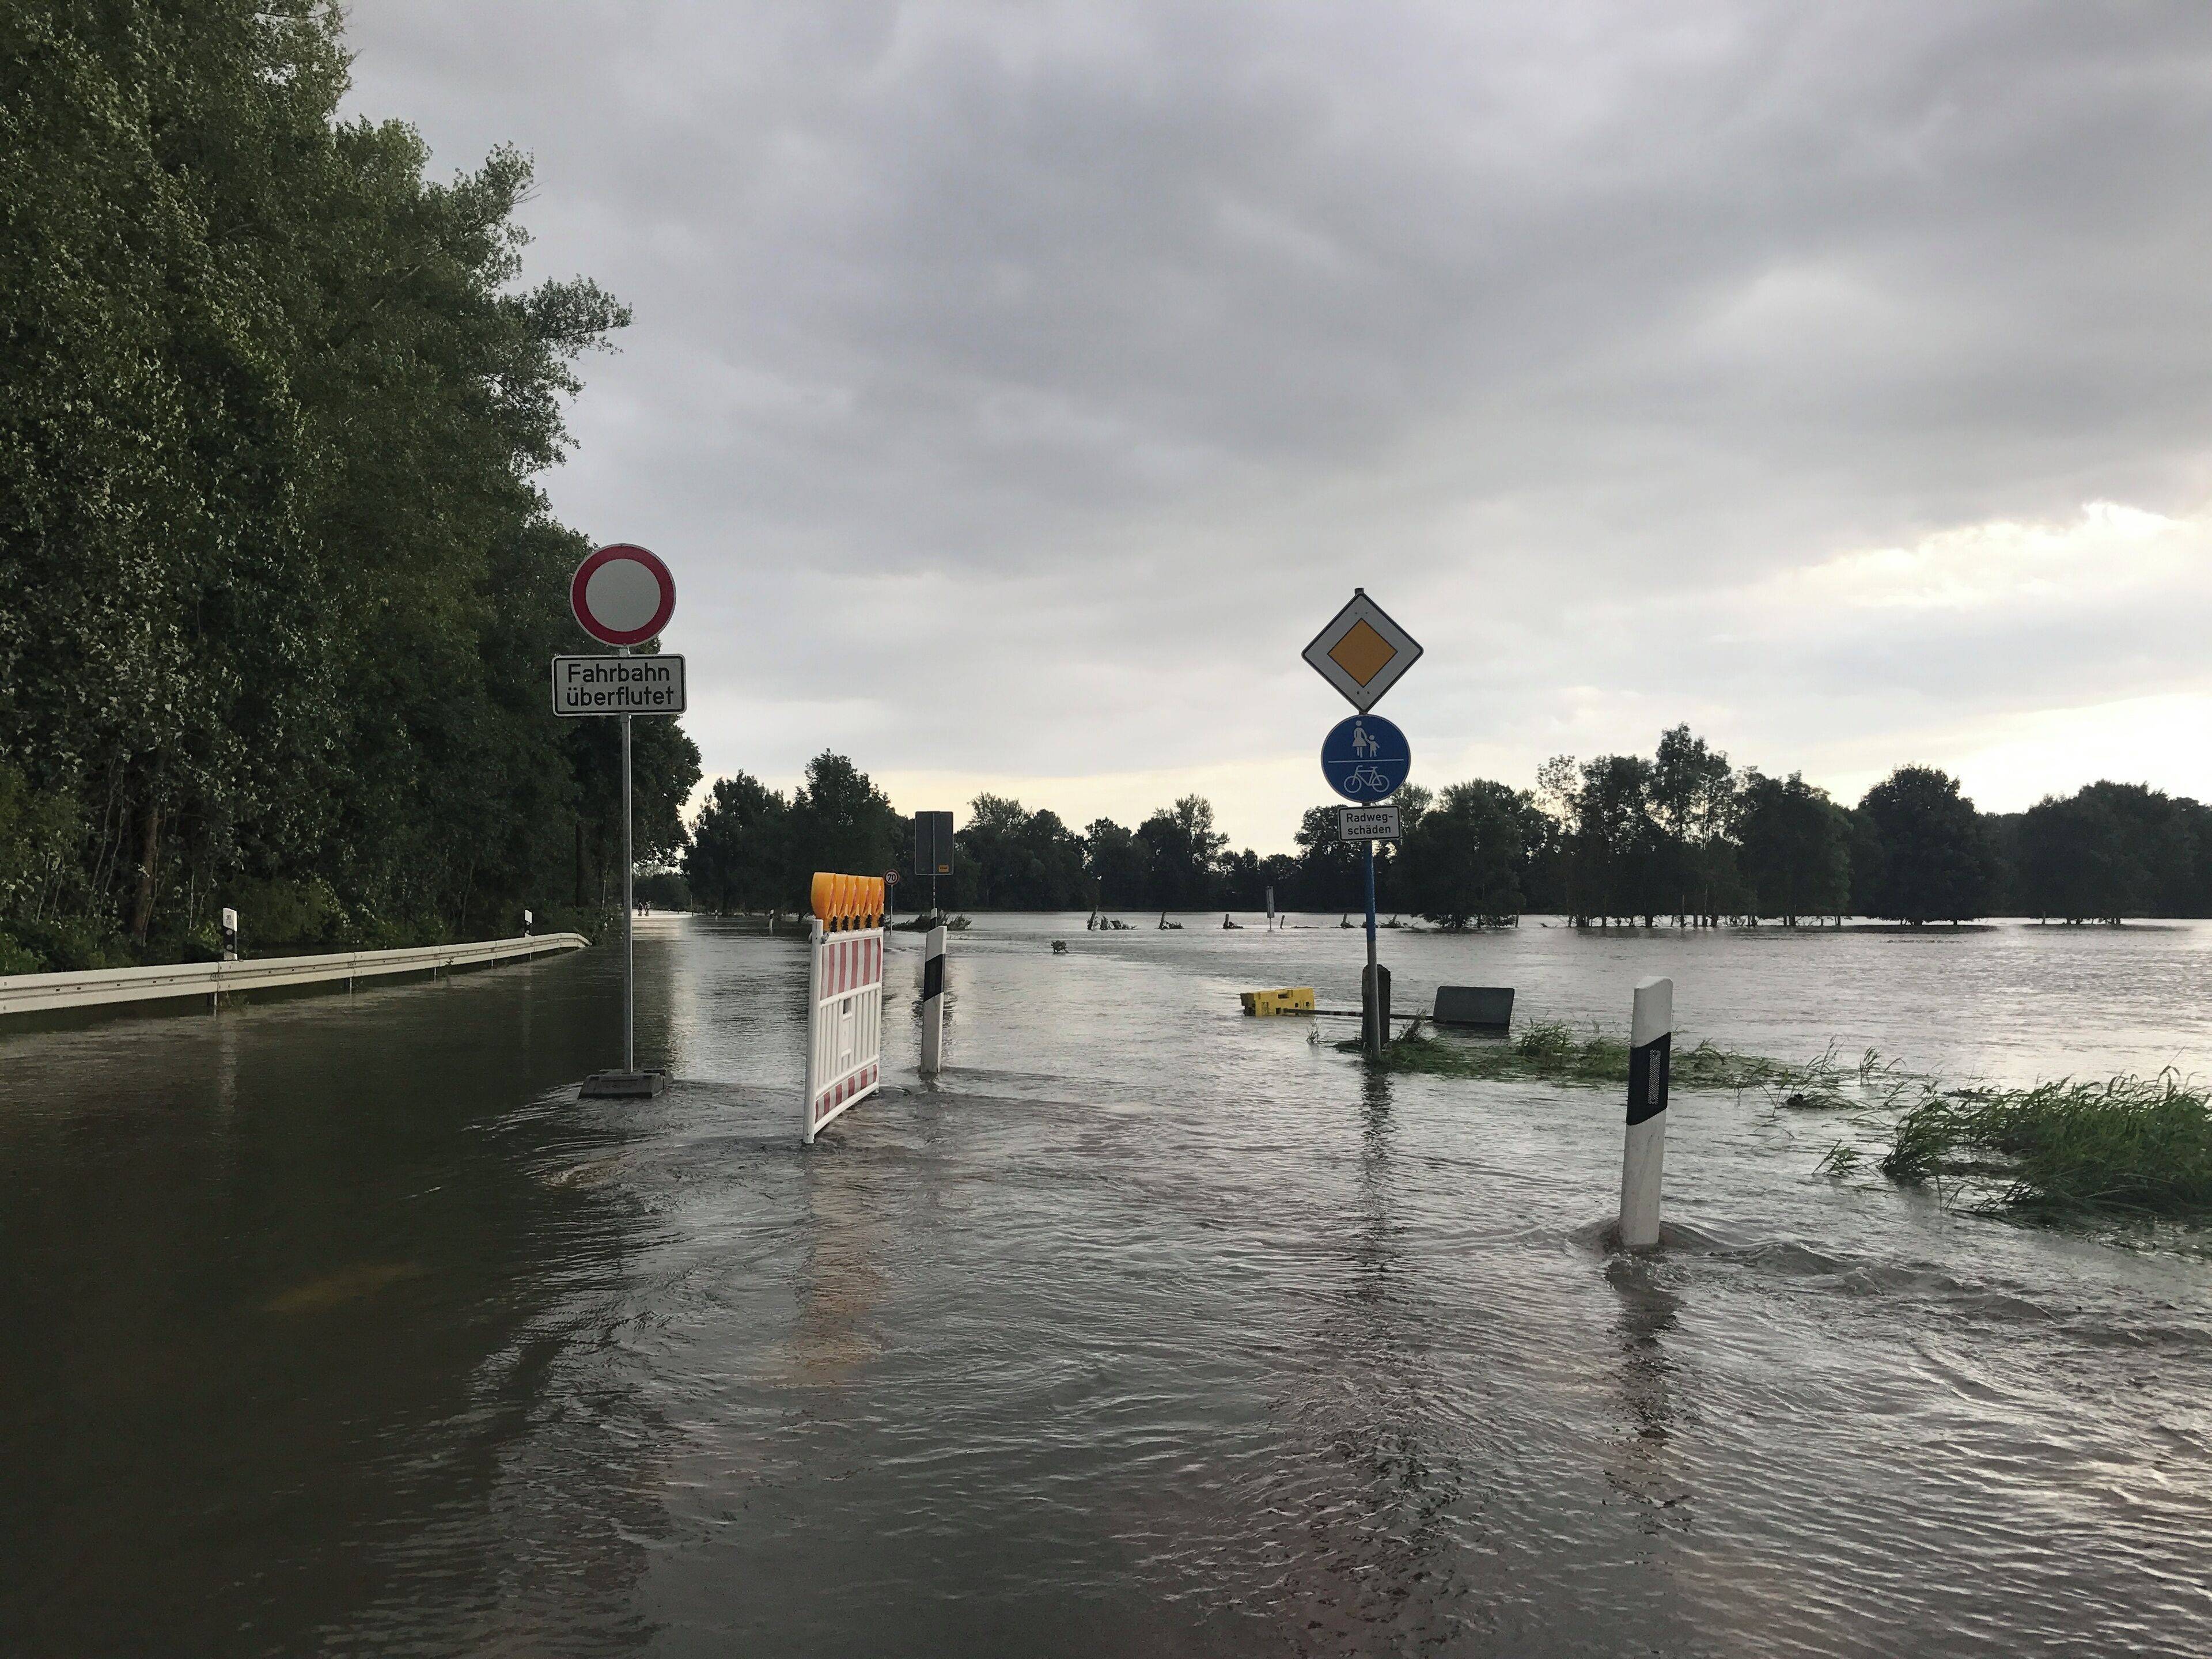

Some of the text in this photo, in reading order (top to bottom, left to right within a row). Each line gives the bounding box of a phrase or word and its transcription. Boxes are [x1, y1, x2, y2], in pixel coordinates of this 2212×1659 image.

[568, 662, 670, 683] Fahrbahn
[567, 686, 674, 706] überflutet
[1346, 813, 1393, 823] Radweg-
[1347, 825, 1391, 835] schäden
